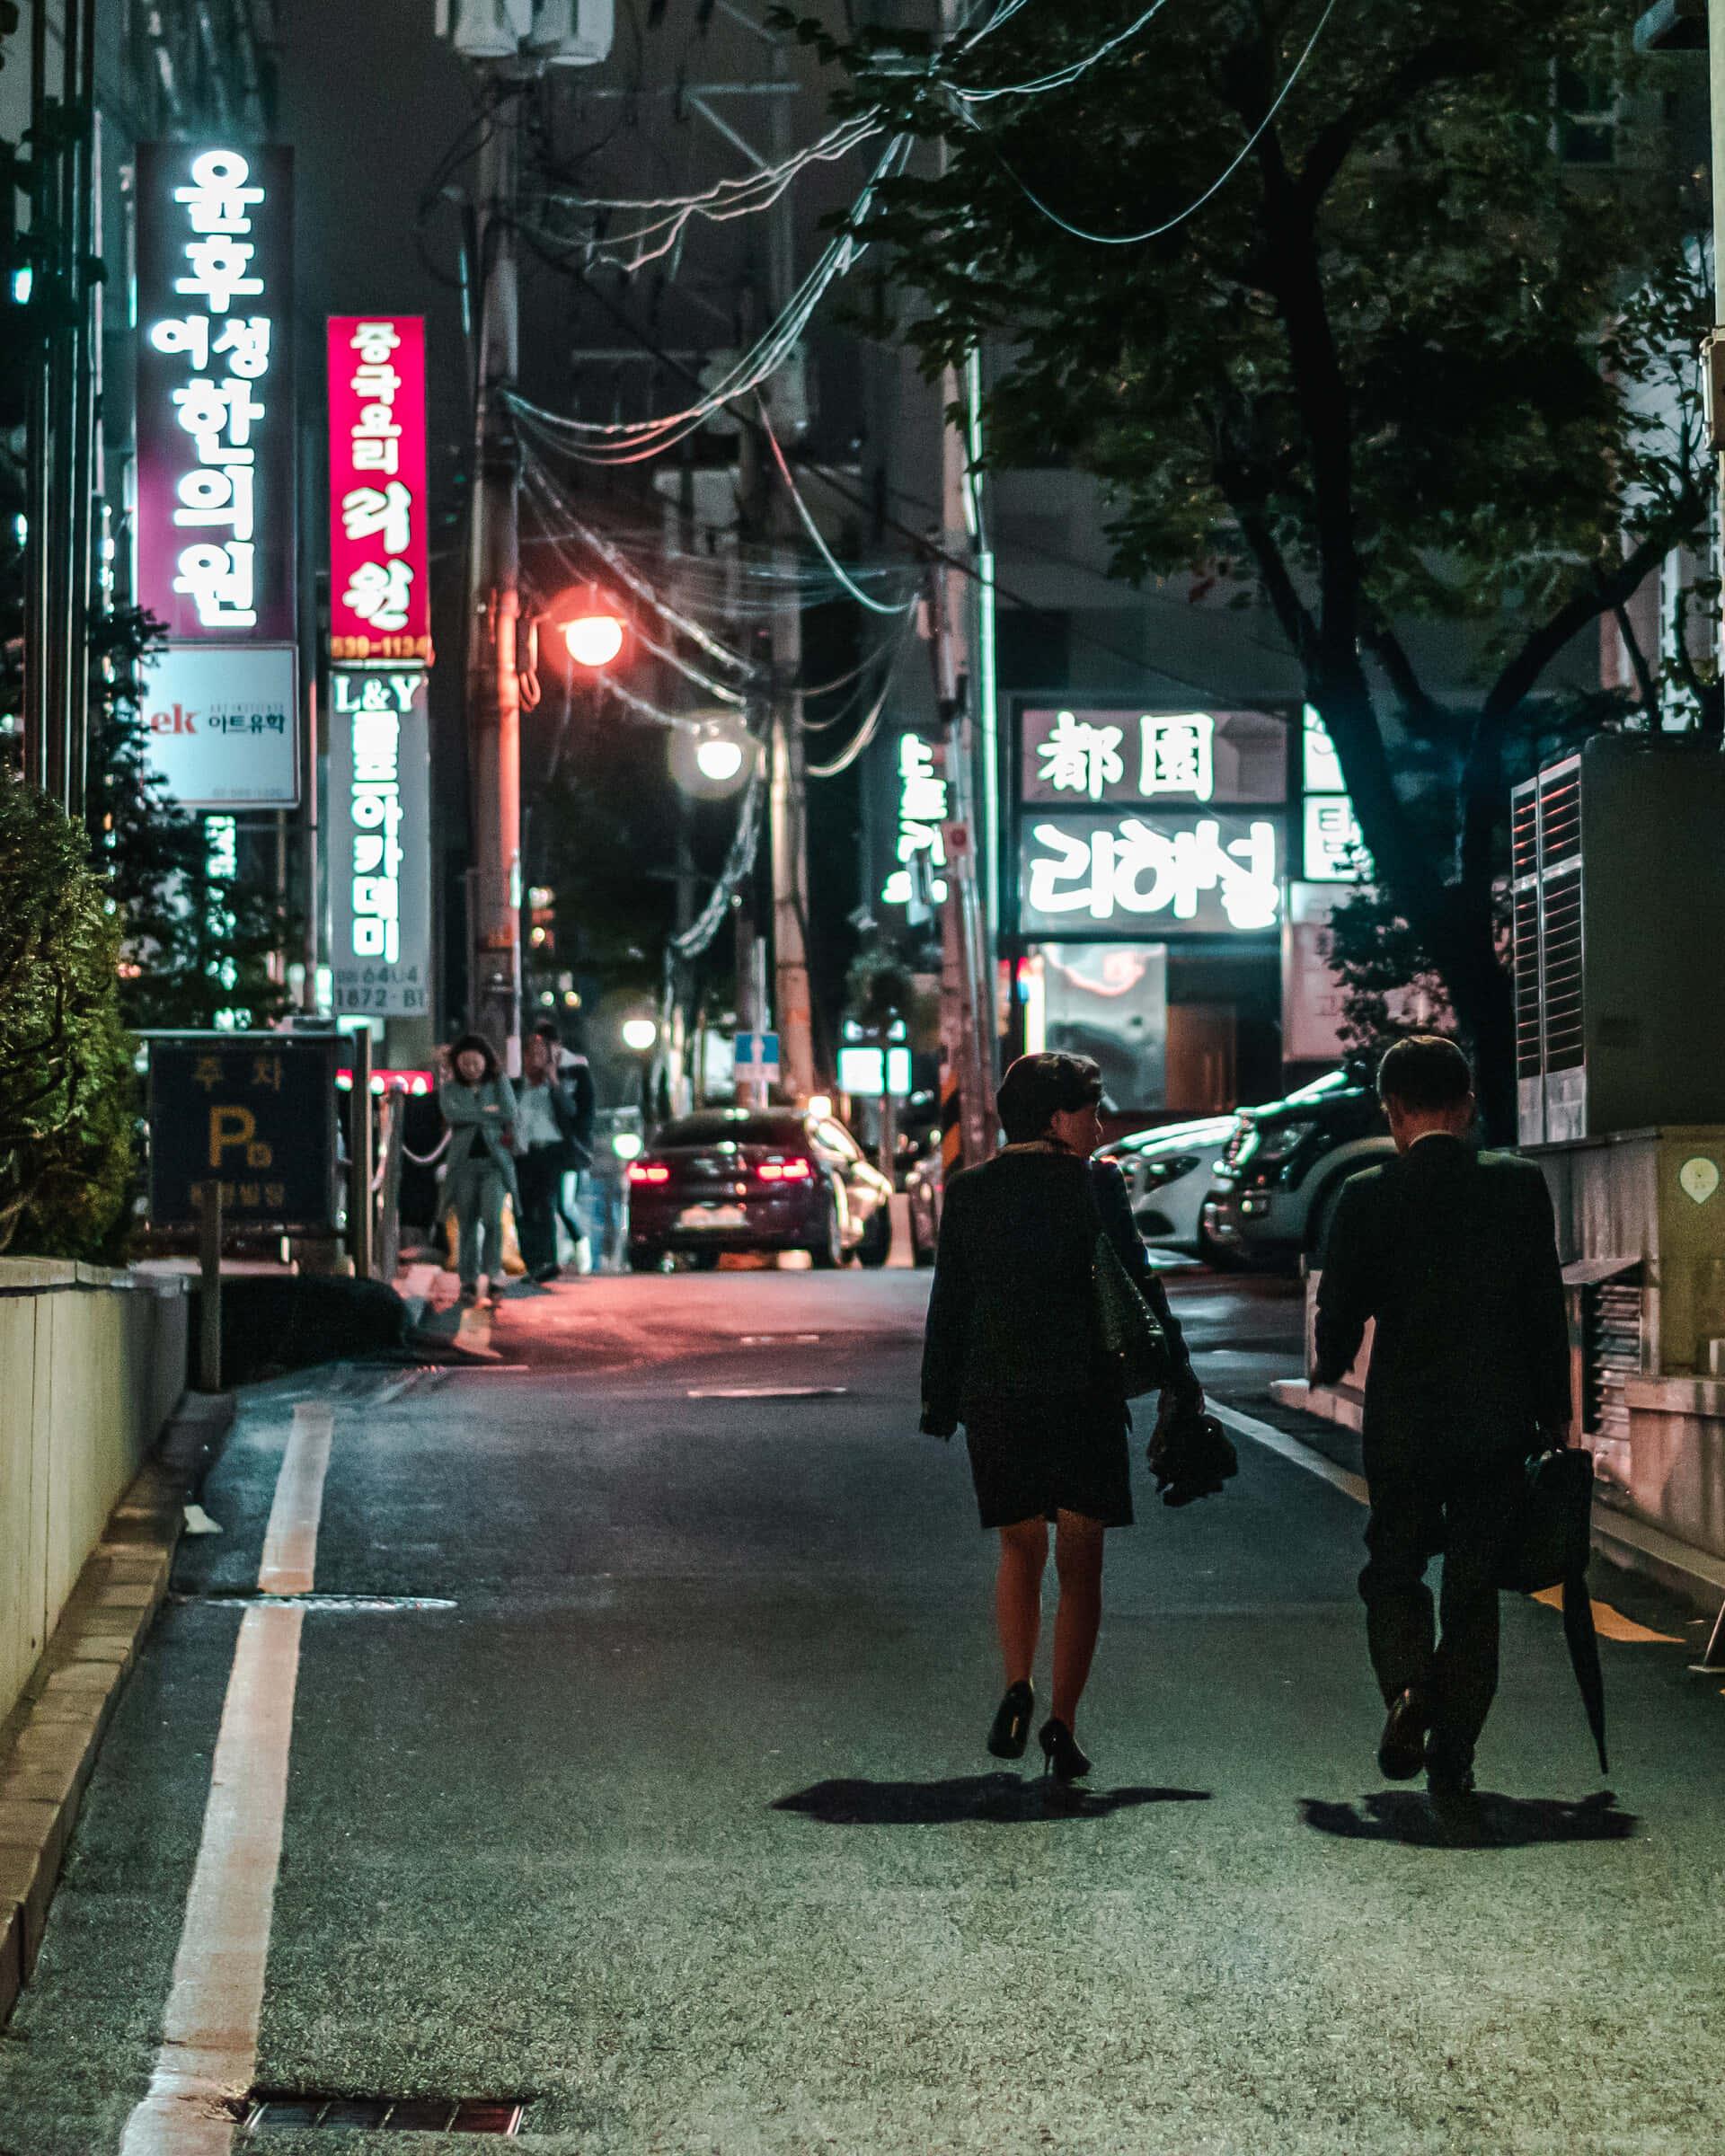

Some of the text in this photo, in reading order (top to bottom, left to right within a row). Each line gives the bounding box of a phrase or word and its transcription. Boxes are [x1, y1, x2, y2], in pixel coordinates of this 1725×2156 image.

[149, 315, 270, 378] 여성
[349, 323, 402, 475] 중국요리
[172, 378, 265, 626] 한의원
[334, 674, 422, 713] L&Y
